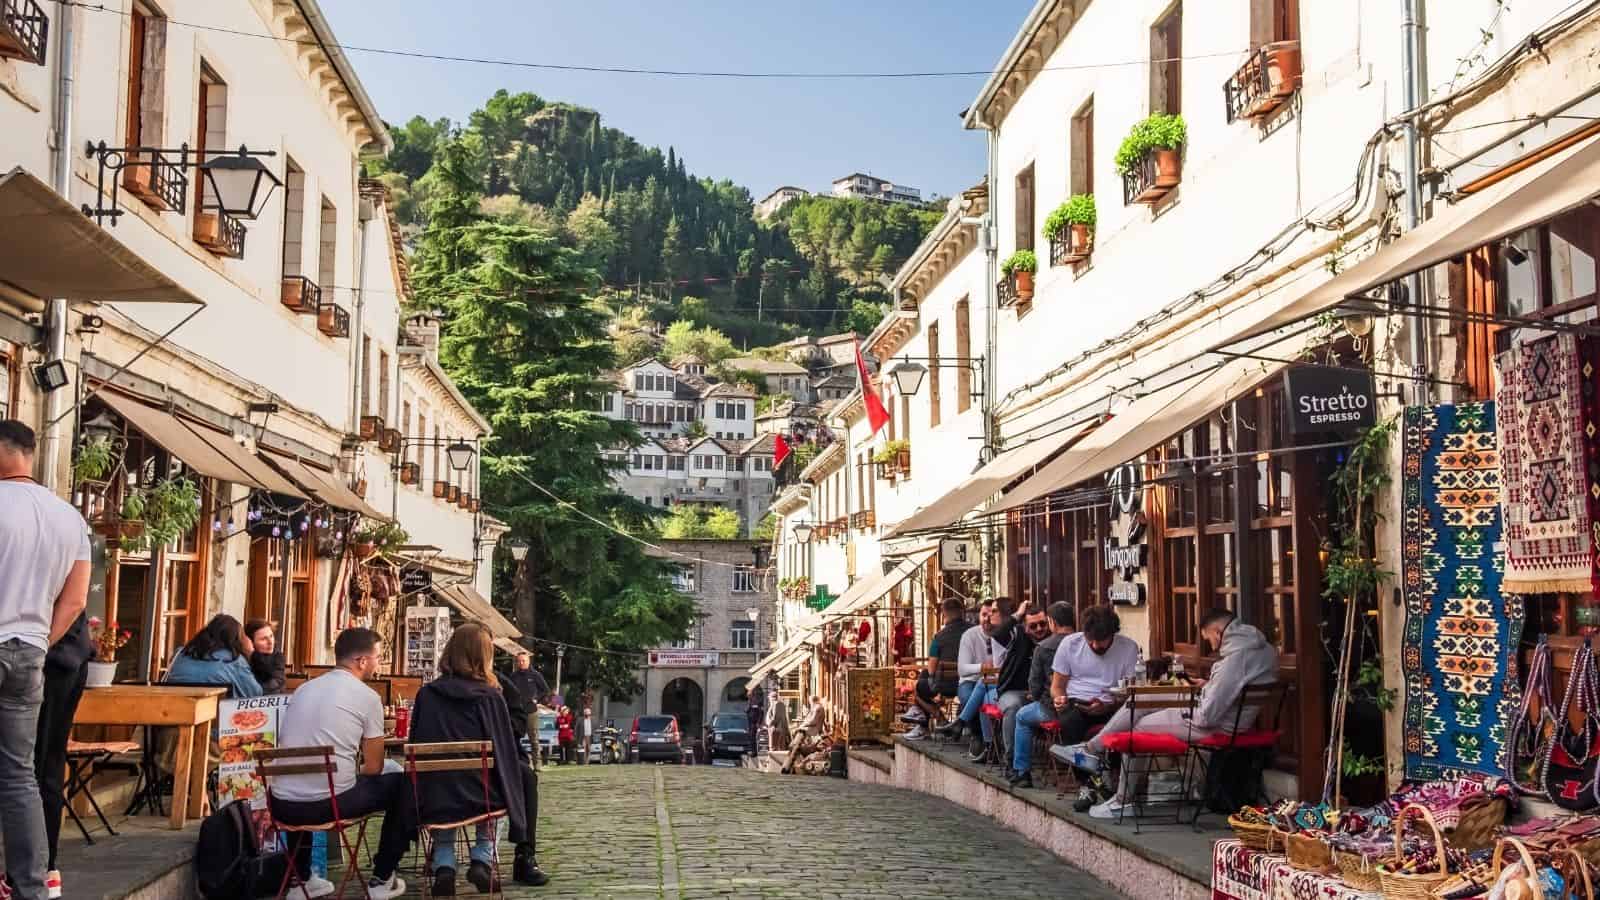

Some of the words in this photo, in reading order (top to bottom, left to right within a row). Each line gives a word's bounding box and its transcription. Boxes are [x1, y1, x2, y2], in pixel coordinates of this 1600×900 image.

[1299, 393, 1368, 413] Stretto
[1310, 411, 1360, 424] ESPRESSO
[237, 696, 280, 710] PICERI
